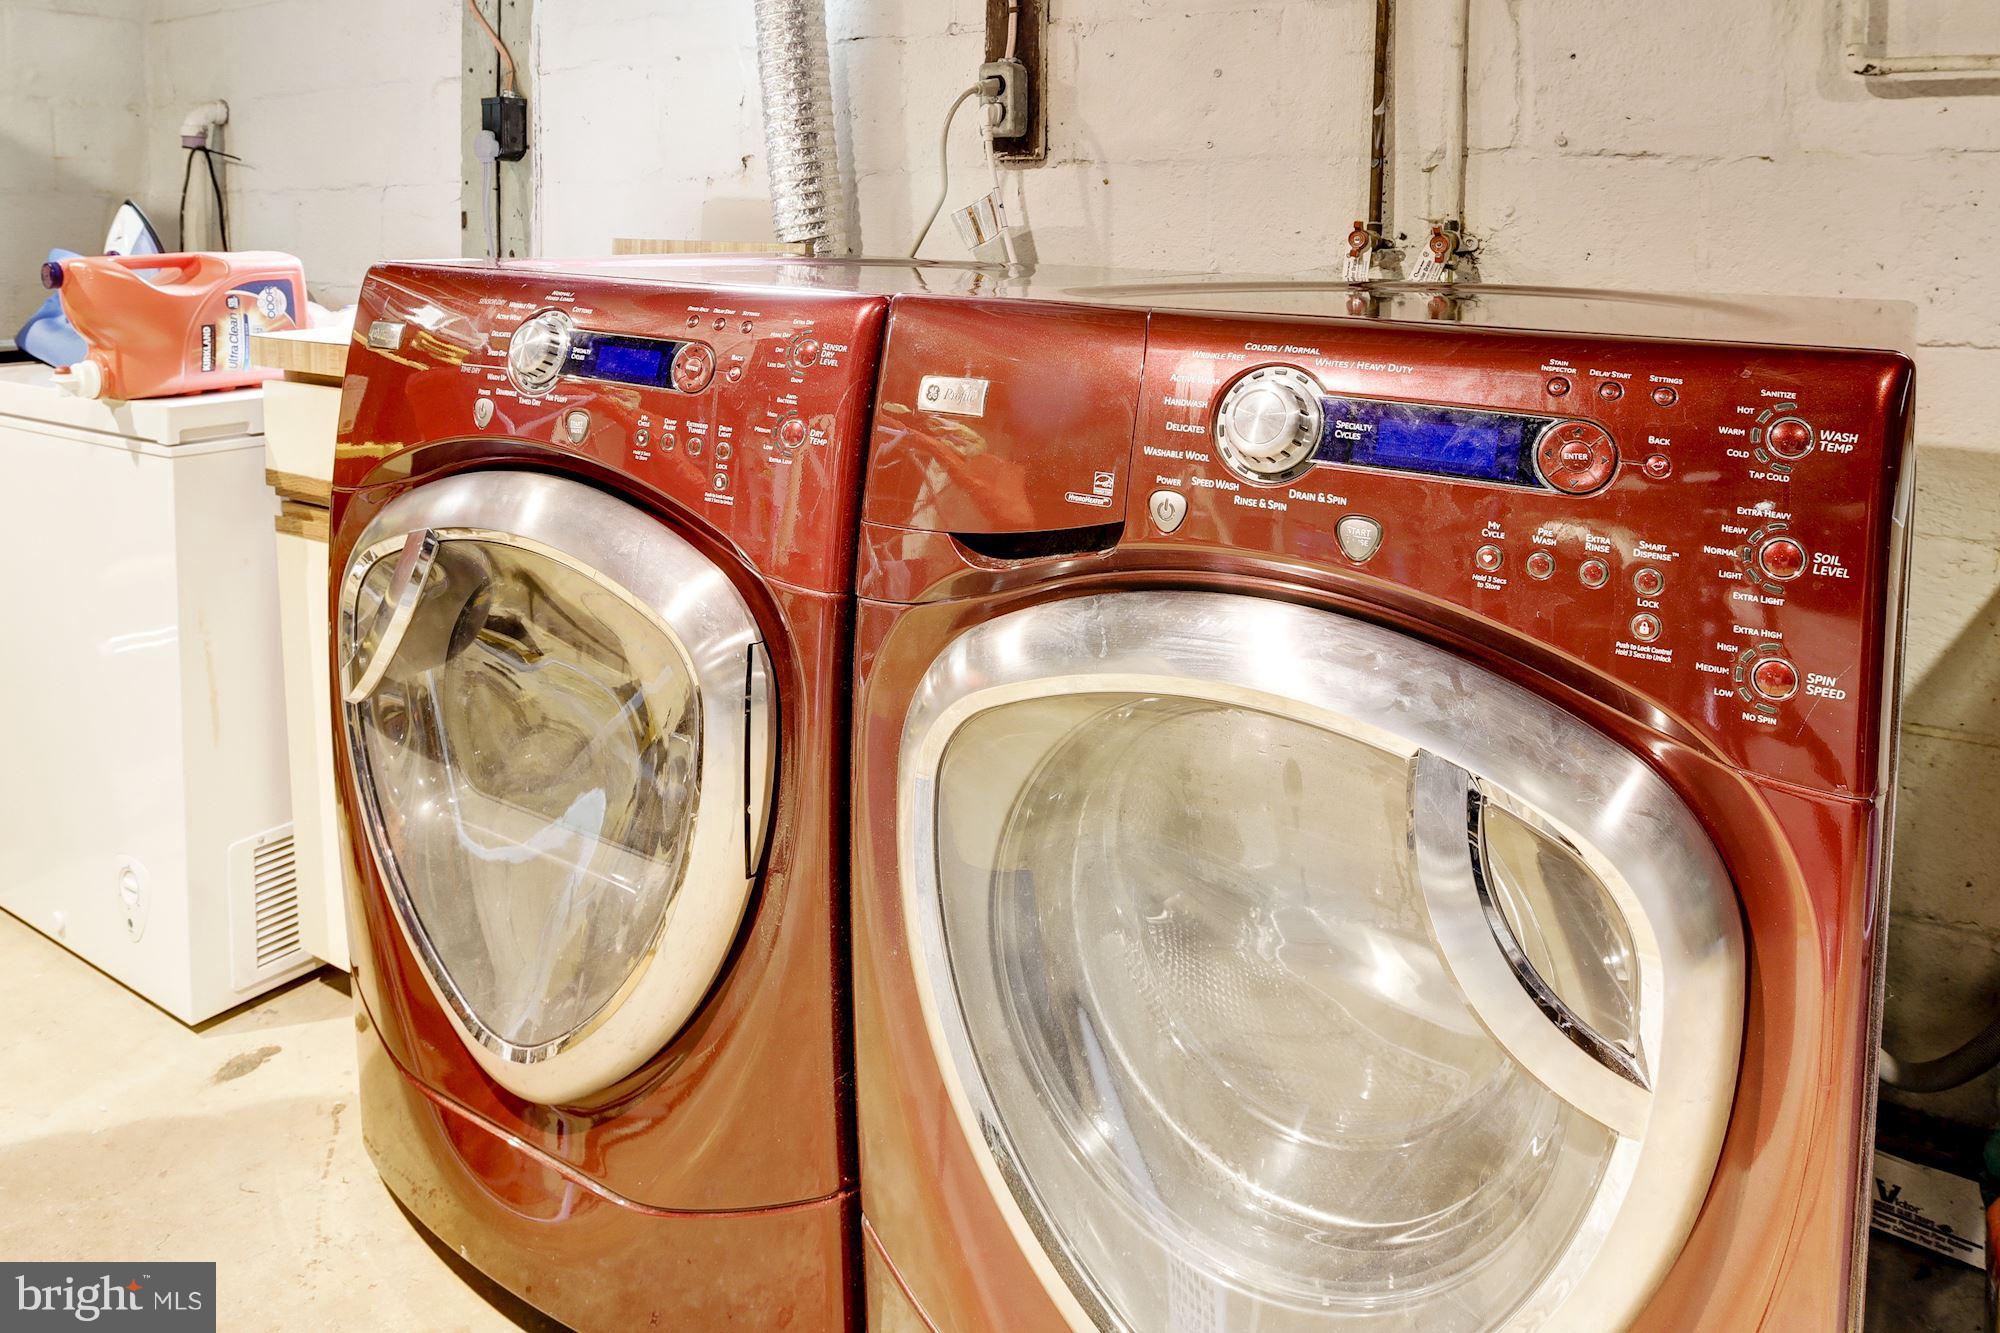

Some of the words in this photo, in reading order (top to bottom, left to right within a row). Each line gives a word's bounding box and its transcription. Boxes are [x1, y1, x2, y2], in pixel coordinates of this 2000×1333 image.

[202, 326, 212, 372] KIRKLAND
[822, 342, 848, 352] SENSOR
[1244, 342, 1276, 352] COLORS
[1284, 344, 1320, 355] NORMAL
[1192, 350, 1226, 360] WRINKLE
[1226, 352, 1246, 362] FREE
[820, 358, 839, 367] LEVEL
[1314, 358, 1348, 368] WHITES
[1356, 361, 1386, 372] HEAVY
[1388, 364, 1414, 374] DUTY
[1550, 358, 1569, 368] STAIN
[1541, 364, 1577, 374] INSPECTOR
[1590, 368, 1610, 379] DELAY
[1610, 370, 1632, 380] START
[1649, 374, 1684, 386] SETTINGS
[1760, 389, 1796, 400] SANITIZE
[1164, 396, 1208, 408] HANDWASH
[1737, 406, 1755, 415] HOT
[1166, 422, 1206, 434] DELICATES
[1336, 420, 1373, 432] SPECIALTY
[1718, 426, 1746, 436] WARM
[810, 429, 825, 438] DRY
[1334, 430, 1361, 440] CYCLES
[1820, 430, 1858, 444] WASH
[810, 436, 828, 446] TEMP
[1648, 436, 1670, 447] BACK
[1726, 448, 1750, 458] COLD
[1818, 441, 1854, 454] TEMP
[1144, 446, 1184, 460] WASHABLE
[1184, 450, 1210, 462] WOOL
[1564, 452, 1588, 461] ENTER
[1156, 475, 1182, 486] POWER
[1749, 470, 1766, 480] TAP
[1766, 472, 1790, 483] COLD
[1192, 476, 1214, 490] SPEED
[1215, 479, 1240, 492] WASH
[1234, 495, 1258, 508] RINSE
[1258, 498, 1266, 509] &
[1267, 498, 1288, 512] SPIN
[1289, 489, 1316, 502] DRAIN
[1317, 492, 1326, 503] &
[1326, 493, 1347, 506] SPIN
[1737, 506, 1763, 518] EXTRA
[1764, 510, 1792, 520] HEAVY
[1487, 520, 1501, 531] MY
[1721, 524, 1748, 535] HEAVY
[1482, 528, 1505, 540] CYCLE
[1538, 528, 1553, 538] PRE
[1532, 535, 1557, 546] WASH
[1586, 534, 1611, 545] EXTRA
[1585, 542, 1610, 554] RINSE
[1638, 540, 1667, 552] SMART
[1704, 546, 1738, 558] NORMAL
[1813, 552, 1842, 566] SOIL
[1718, 570, 1743, 580] LIGHT
[1812, 566, 1850, 579] LEVEL
[1472, 573, 1486, 584] Hold
[1487, 574, 1492, 583] 3
[1492, 576, 1507, 585] Secs
[1484, 582, 1501, 590] Store
[1636, 597, 1660, 610] LOCK
[1732, 592, 1758, 602] EXTRA
[1760, 595, 1785, 606] LIGHT
[1733, 625, 1759, 636] EXTRA
[1760, 628, 1783, 640] HIGH
[1616, 640, 1630, 651] Push
[1630, 644, 1637, 652] to
[1637, 644, 1650, 654] Lock
[1650, 645, 1672, 656] Control
[1716, 642, 1738, 652] HIGH
[1615, 648, 1628, 658] Hold
[1632, 650, 1646, 660] Secs
[1646, 652, 1652, 660] to
[1652, 653, 1672, 663] Unlock
[1695, 662, 1730, 674] MEDIUM
[1806, 672, 1836, 687] SPIN
[1714, 688, 1734, 698] LOW
[1806, 685, 1846, 701] SPEED
[1742, 712, 1756, 722] NO
[1757, 714, 1777, 726] SPIN
